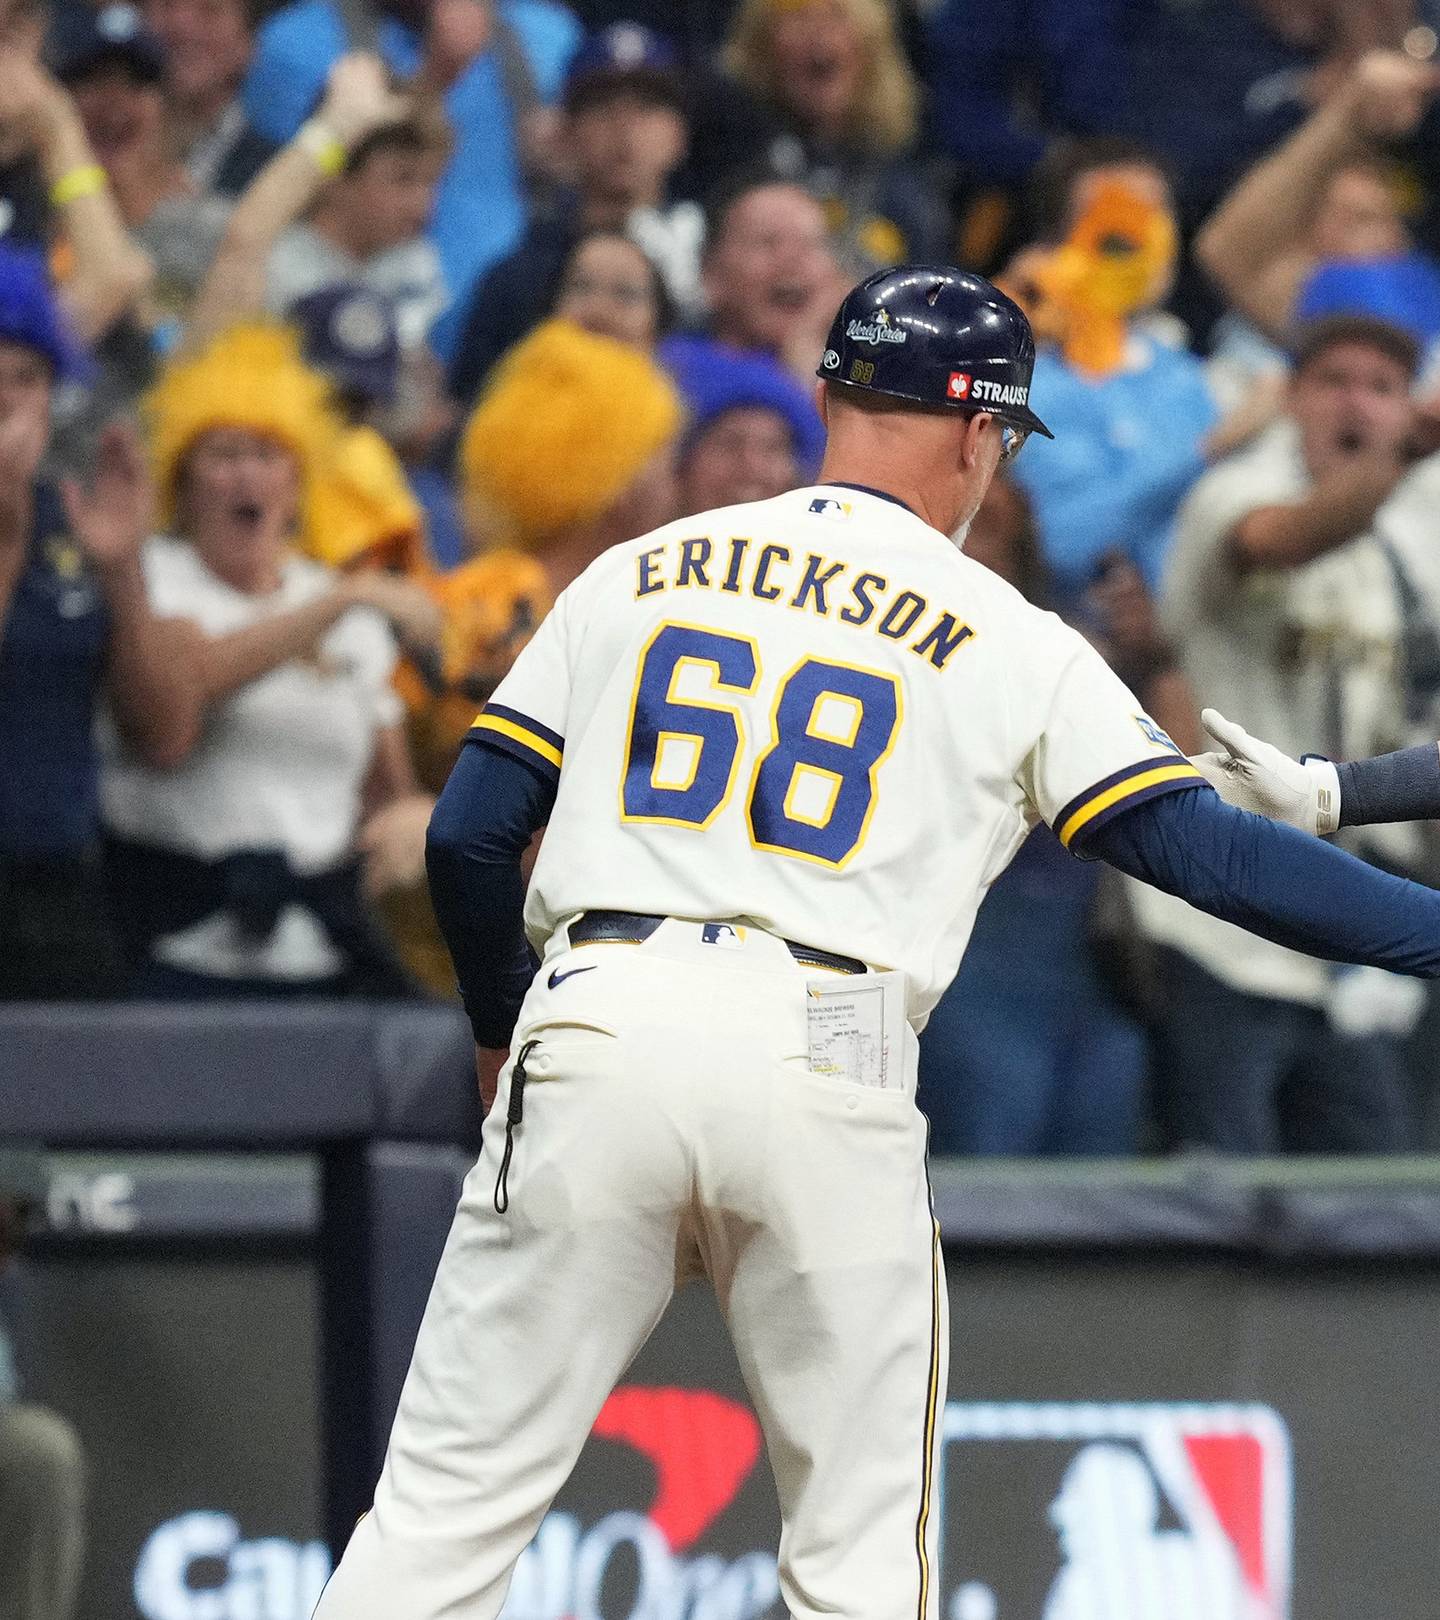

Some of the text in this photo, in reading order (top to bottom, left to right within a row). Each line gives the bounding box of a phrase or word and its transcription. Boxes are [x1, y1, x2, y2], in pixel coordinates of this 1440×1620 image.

[971, 379, 1028, 406] STRAUSS
[634, 535, 978, 674] ERICKSON
[619, 619, 904, 872] 68
